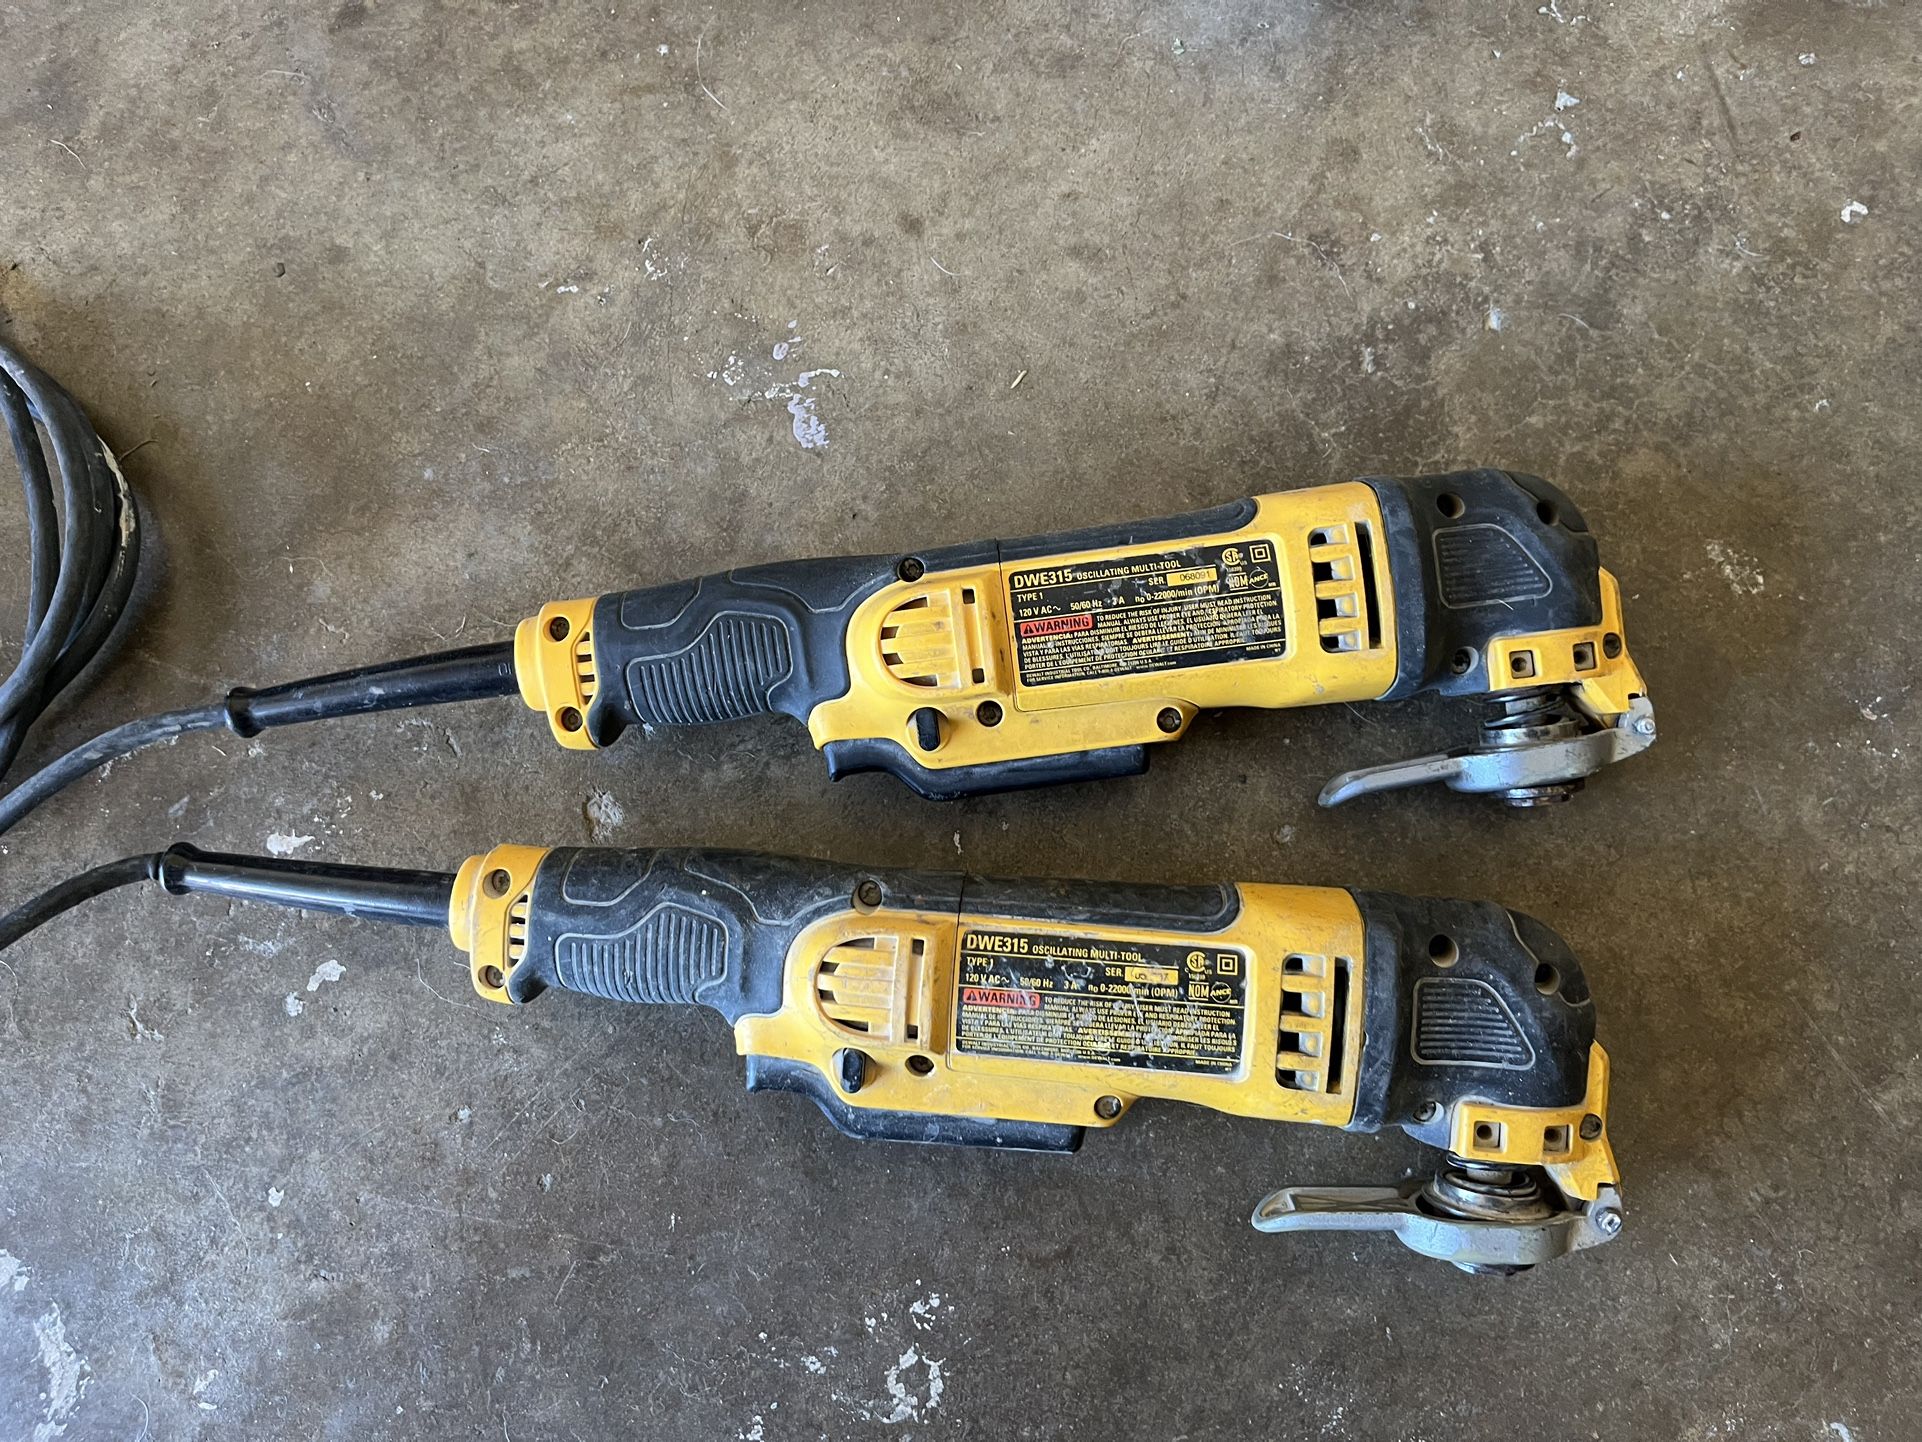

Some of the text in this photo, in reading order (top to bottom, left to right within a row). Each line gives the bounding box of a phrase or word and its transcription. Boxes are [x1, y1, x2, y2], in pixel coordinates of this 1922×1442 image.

[1013, 559, 1181, 588] DWE315 OSCILLATING MULTI-TOOL
[1147, 570, 1211, 586] SER. 068091
[1228, 574, 1248, 588] NOM
[1016, 591, 1043, 602] TYPE 1
[1018, 607, 1032, 617] 120
[1032, 606, 1039, 616] V
[1069, 600, 1091, 611] 50/60
[1091, 598, 1103, 608] Hz
[1111, 596, 1118, 605] 3
[1117, 595, 1125, 605] A
[1145, 586, 1192, 601] 0-22000/min
[1192, 583, 1220, 595] (OPM)
[1096, 614, 1104, 622] TO
[1104, 611, 1126, 621] REDUCE
[1127, 610, 1138, 618] THE
[1138, 608, 1152, 616] RISK
[1152, 607, 1161, 615] OF
[1199, 600, 1216, 609] MUST
[1232, 593, 1271, 605] INSTRUCTION
[1032, 615, 1090, 633] WARNING
[1122, 616, 1146, 625] ALWAYS
[1146, 614, 1158, 622] USE
[1191, 608, 1204, 616] AND
[1073, 629, 1089, 638] PARA
[1089, 625, 1120, 636] DISMINUIR
[1148, 621, 1157, 629] DE
[1022, 649, 1039, 658] VISTA
[1043, 647, 1060, 655] PARA
[1060, 645, 1071, 653] LAS
[966, 933, 1143, 962] DWE315 OSCILLATING MULTI-TOOL
[965, 955, 988, 967] TYPE
[1104, 966, 1124, 977] SER.
[965, 972, 979, 982] 120
[1019, 976, 1041, 987] 50/60
[1042, 978, 1054, 988] Hz
[1063, 980, 1069, 989] 3
[1099, 982, 1149, 995] 0-22000min
[1150, 986, 1178, 998] (OPM)
[1188, 983, 1209, 997] NOM
[977, 990, 1036, 1006] WARNING
[1096, 1007, 1108, 1015] USE
[1189, 1007, 1230, 1017] NSTRUCTION
